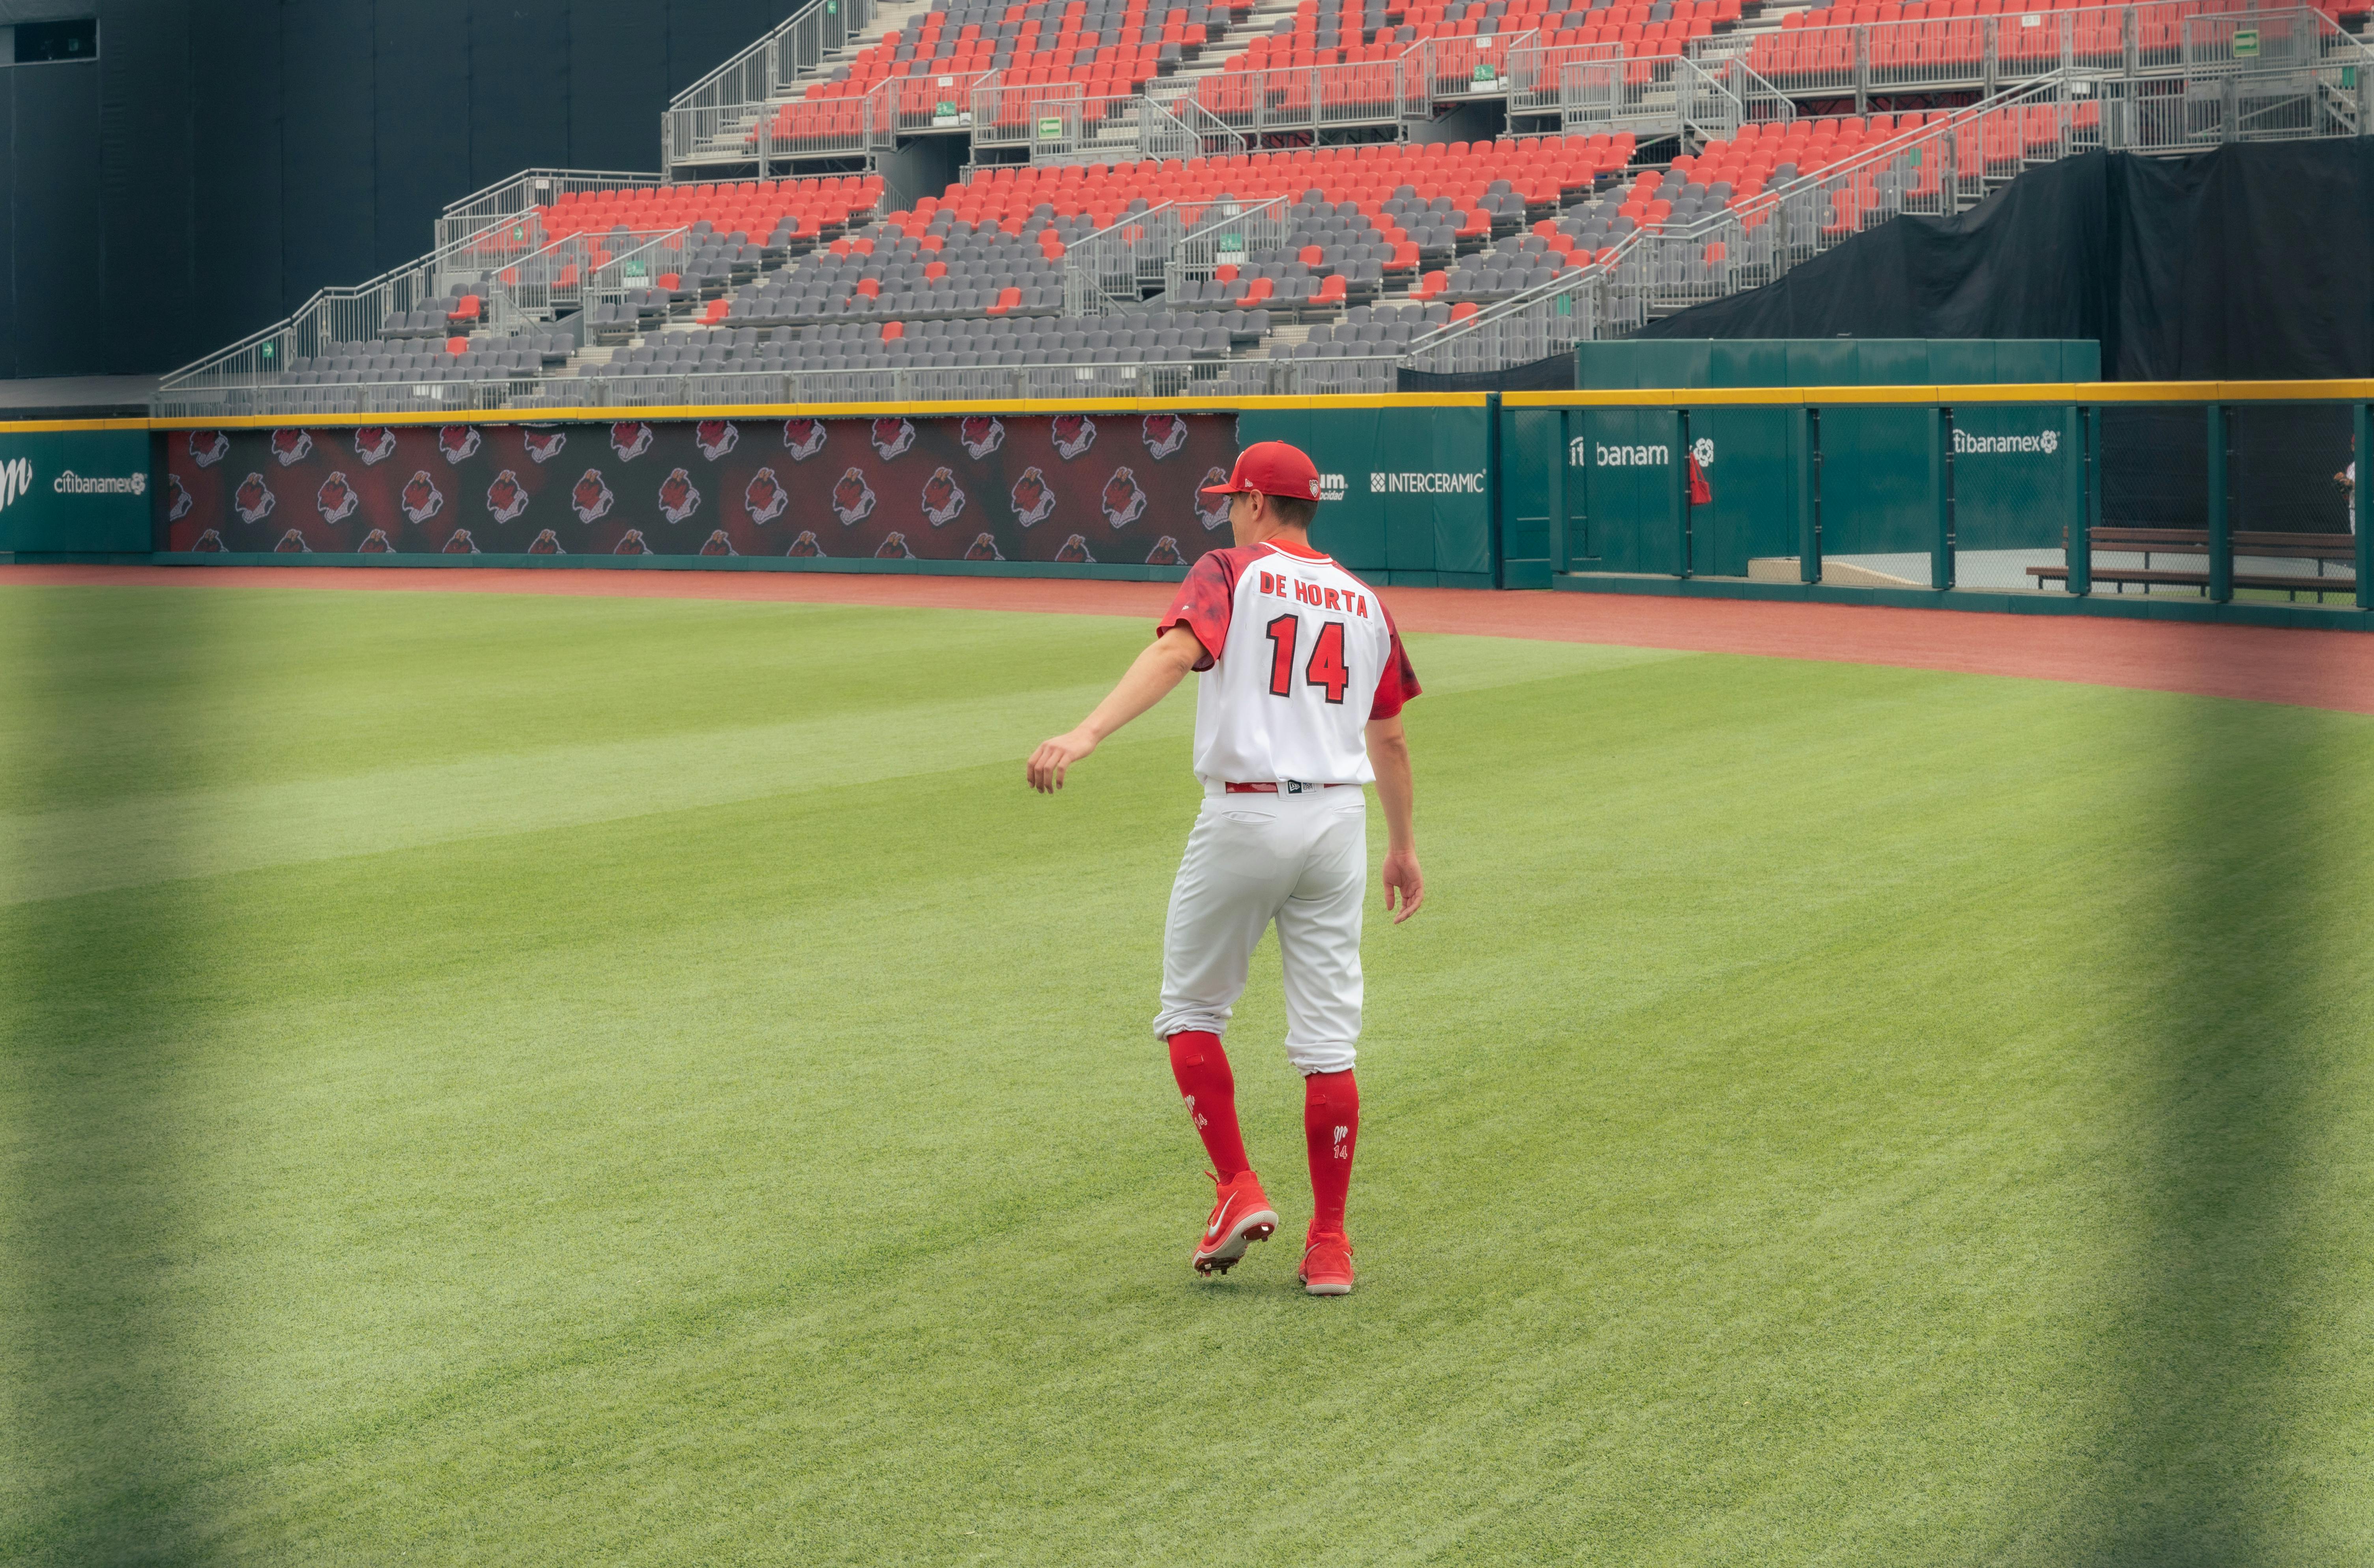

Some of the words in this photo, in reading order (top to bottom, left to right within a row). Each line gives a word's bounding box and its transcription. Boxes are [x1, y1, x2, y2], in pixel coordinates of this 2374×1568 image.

[54, 470, 132, 493] citibanamex
[1388, 473, 1484, 492] INTERCERAMIC
[1319, 490, 1345, 500] ocidad
[1260, 571, 1287, 598] DE
[1294, 578, 1368, 619] HORTA
[1266, 613, 1349, 704] 14
[1194, 1113, 1208, 1129] 14
[1334, 1145, 1348, 1159] 14
